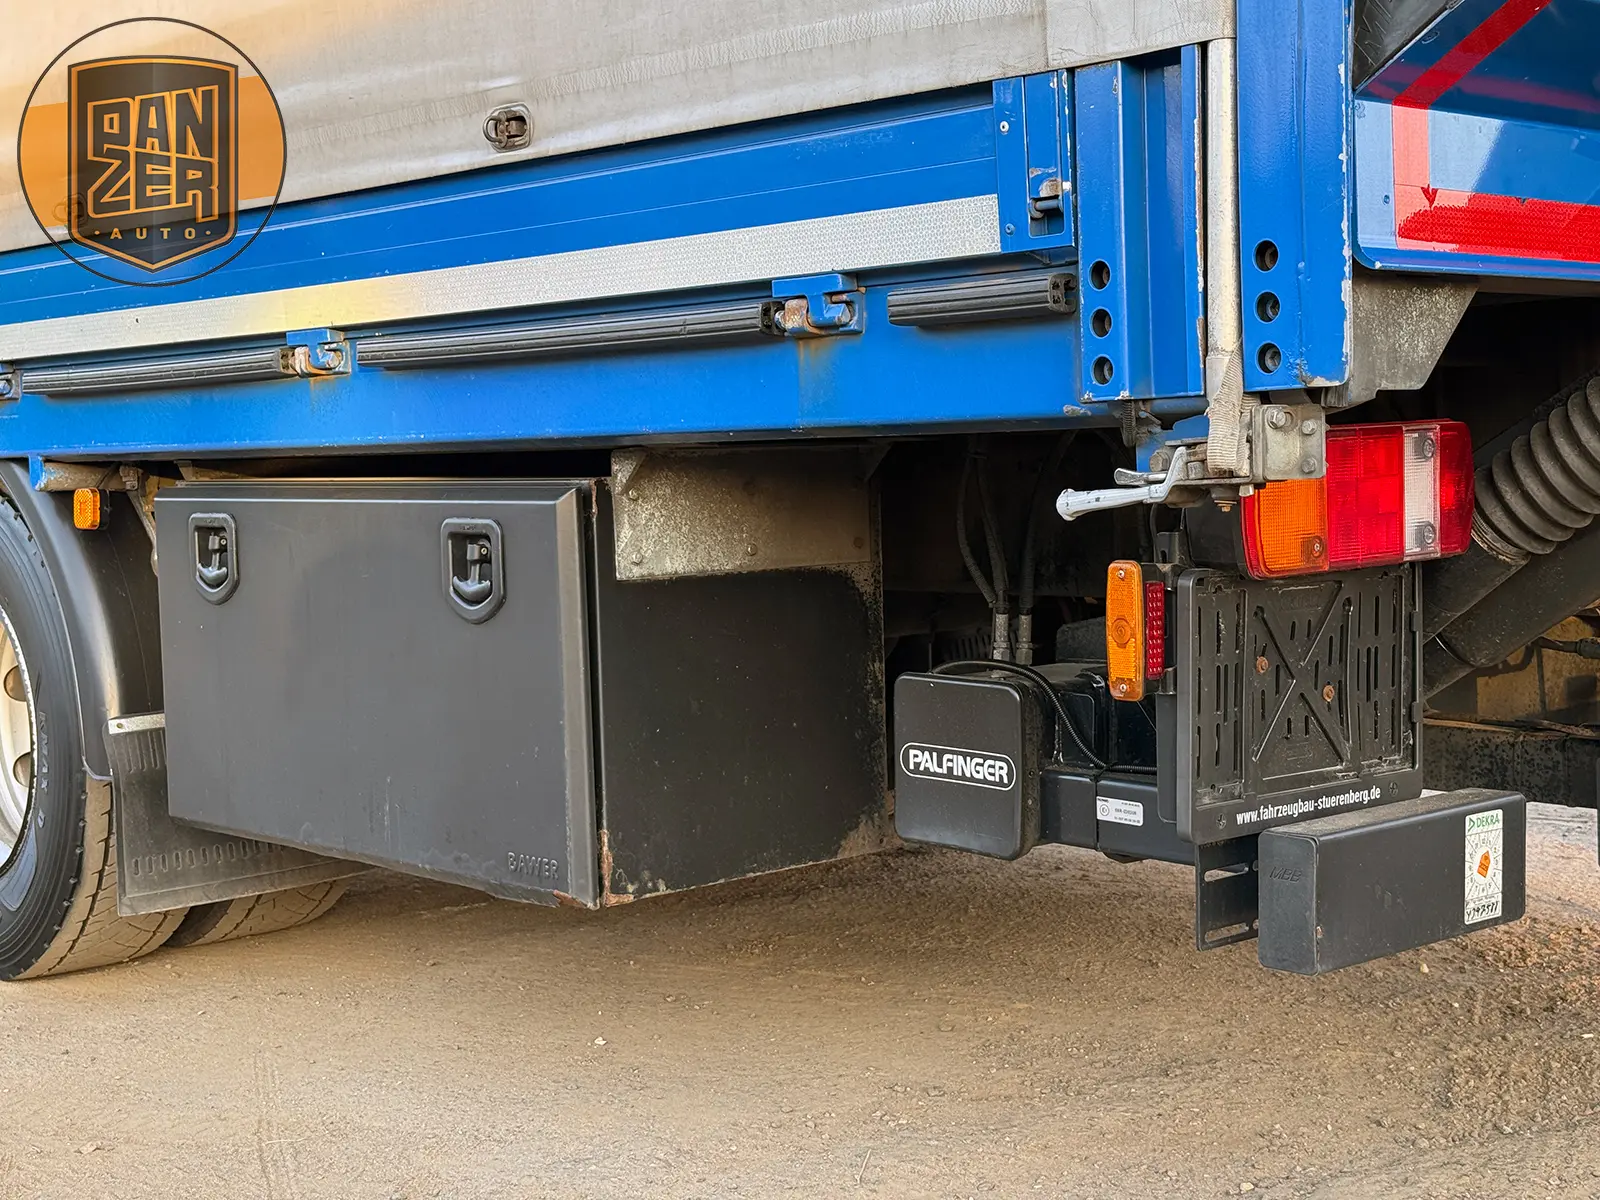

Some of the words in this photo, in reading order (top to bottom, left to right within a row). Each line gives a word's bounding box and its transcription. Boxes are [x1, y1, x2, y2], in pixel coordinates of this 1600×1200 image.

[908, 749, 1009, 784] PALFINGER
[1236, 785, 1381, 825] www.fahrzeugbau-stuerenberg.de
[1476, 813, 1500, 828] DEKRA
[507, 851, 559, 880] BAWER
